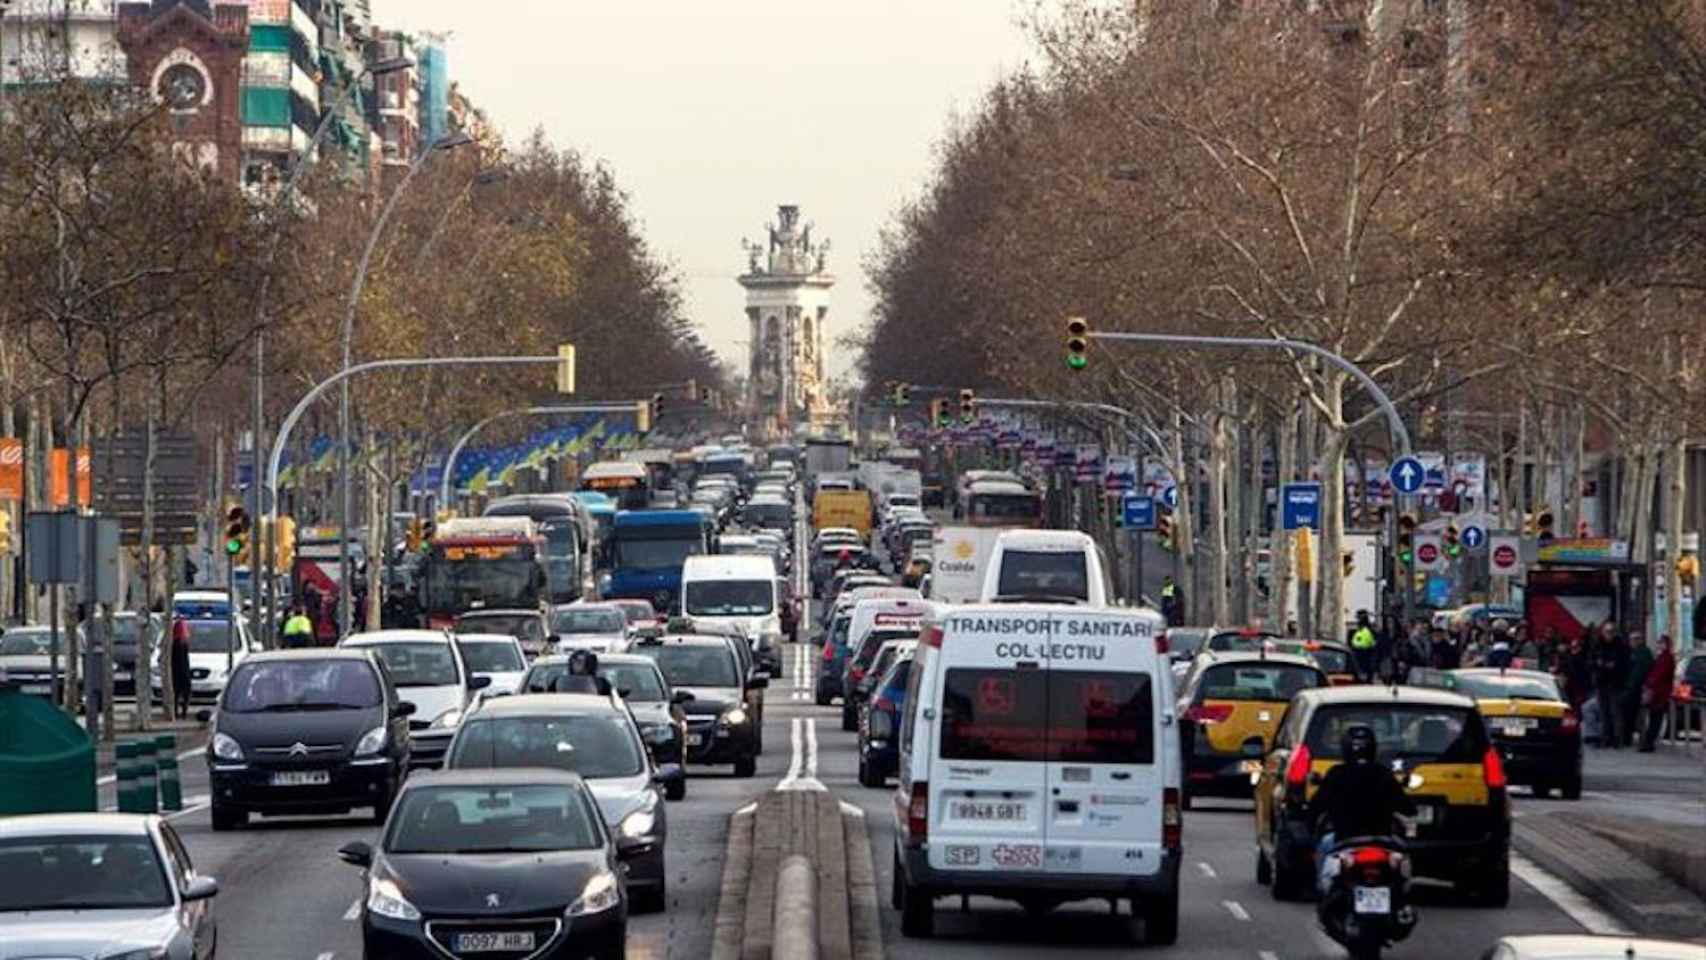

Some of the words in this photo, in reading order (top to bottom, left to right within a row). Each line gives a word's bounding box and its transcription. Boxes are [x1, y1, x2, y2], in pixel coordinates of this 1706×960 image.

[951, 618, 1064, 634] TRANSPORT
[1067, 620, 1153, 637] SANITARI
[996, 643, 1105, 660] COL·LECTIU
